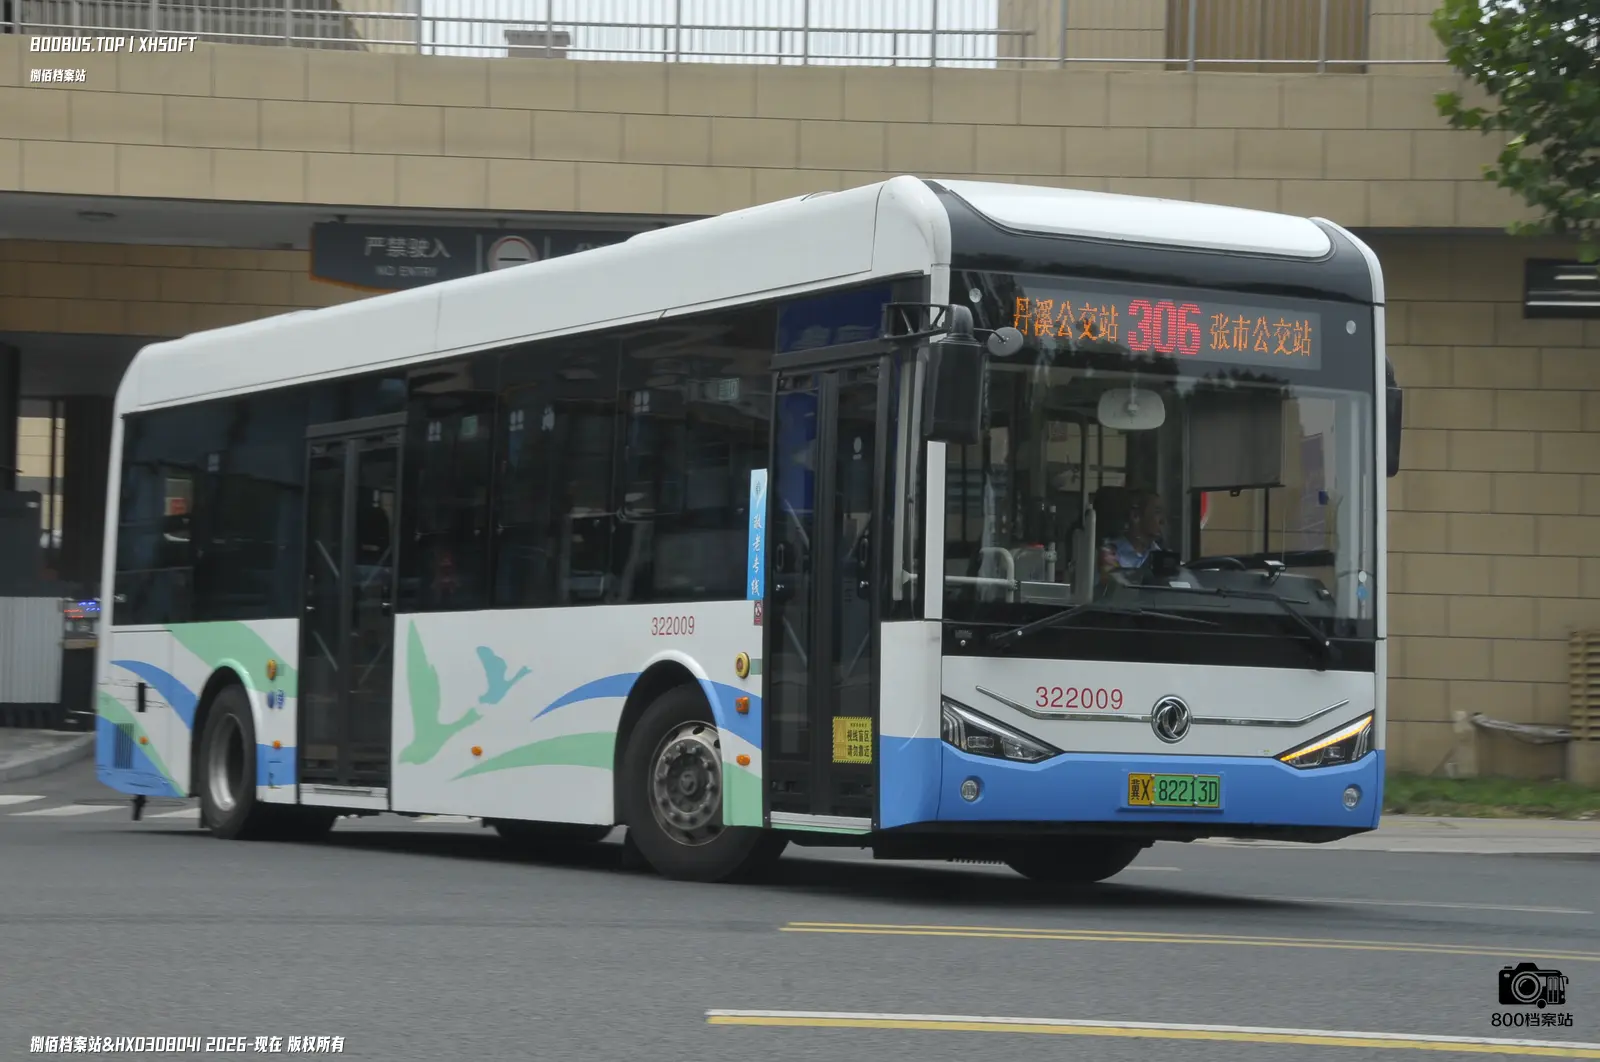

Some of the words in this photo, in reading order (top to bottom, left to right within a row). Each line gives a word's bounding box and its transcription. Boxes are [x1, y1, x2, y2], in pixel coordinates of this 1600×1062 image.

[364, 236, 451, 258] 严禁驶入
[399, 265, 438, 277] ENTRY
[1013, 296, 1119, 342] 丹溪公交站
[1128, 299, 1202, 355] 306
[1209, 312, 1312, 357] 张市公交站
[651, 615, 695, 636] 322009
[1035, 686, 1123, 710] 322009
[847, 729, 870, 742] 视线盲区
[847, 744, 870, 757] 请勿靠近
